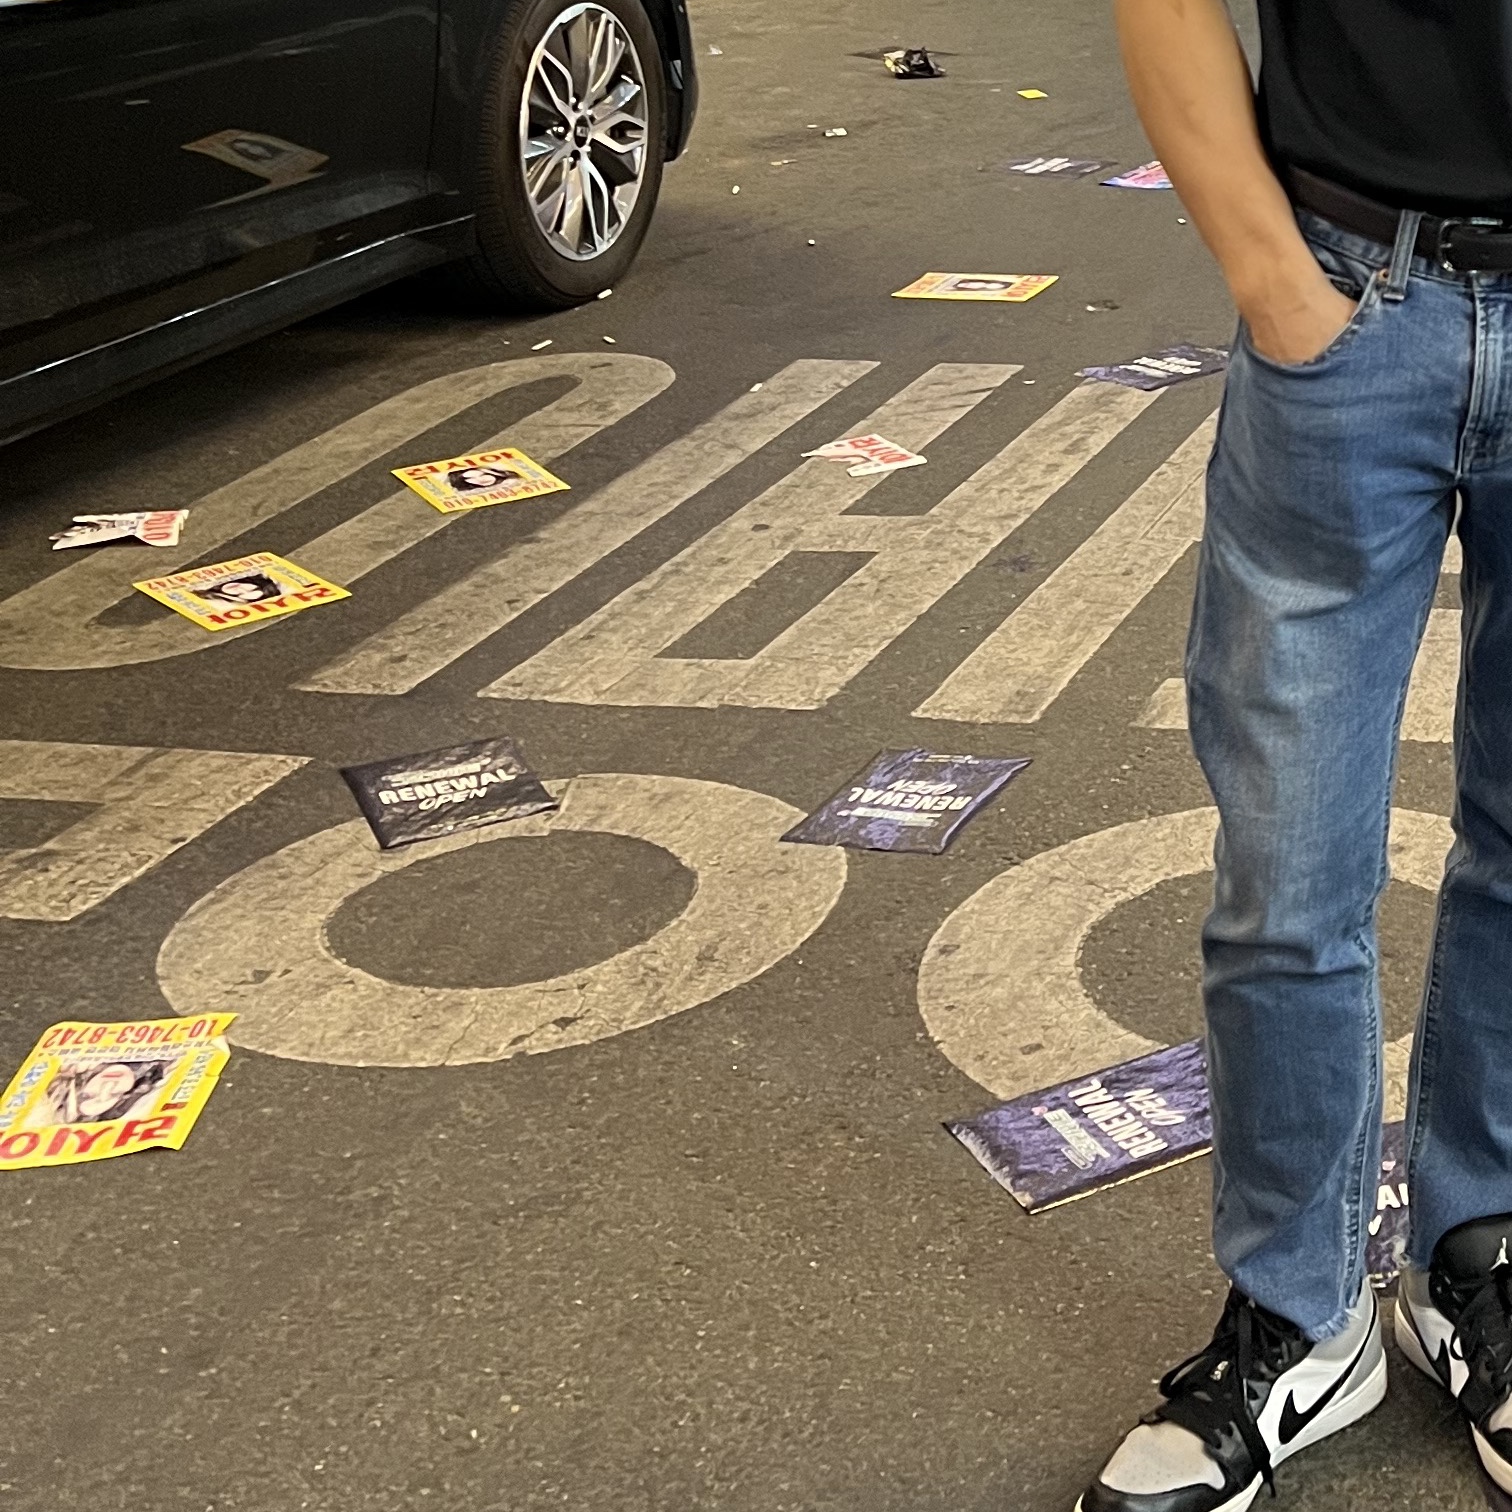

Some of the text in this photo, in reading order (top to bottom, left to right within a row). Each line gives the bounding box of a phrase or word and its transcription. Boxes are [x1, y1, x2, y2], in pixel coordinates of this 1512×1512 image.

[378, 769, 517, 806] RENEWAL
[418, 787, 489, 811] OPEN
[847, 787, 973, 811] RENEWAL
[887, 779, 959, 796] OPEN
[1068, 1078, 1169, 1160] RENEWAL
[1124, 1088, 1187, 1127] OPEN
